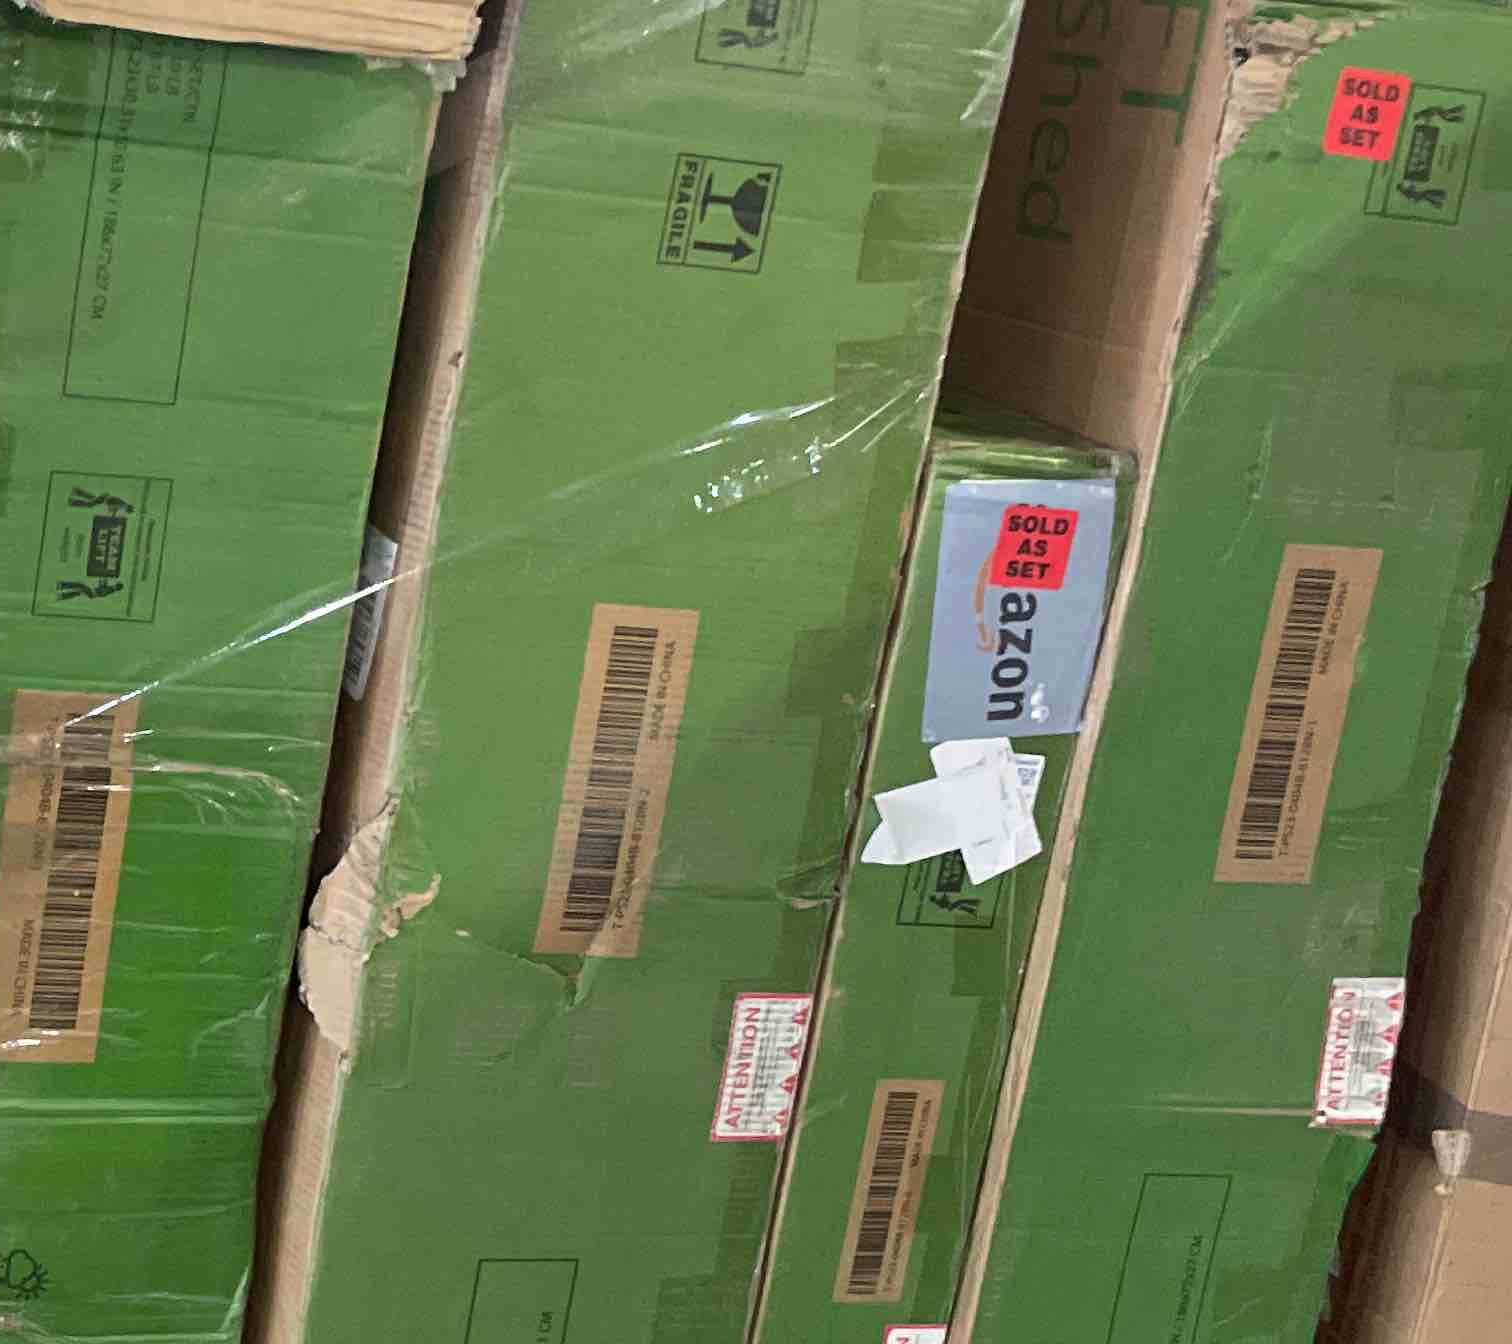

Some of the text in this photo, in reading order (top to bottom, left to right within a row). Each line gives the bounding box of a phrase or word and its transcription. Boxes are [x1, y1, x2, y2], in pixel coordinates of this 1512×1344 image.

[1342, 77, 1401, 102] SOLD
[1350, 105, 1380, 124] AS
[1339, 127, 1381, 150] SET
[664, 159, 700, 259] FRAGILE
[1007, 514, 1070, 537] SOLD
[1016, 539, 1049, 558] AS
[1004, 560, 1052, 581] SET
[985, 591, 1038, 723] azon
[1326, 989, 1357, 1114] ATTENTION
[725, 1005, 762, 1129] ATTENTION
